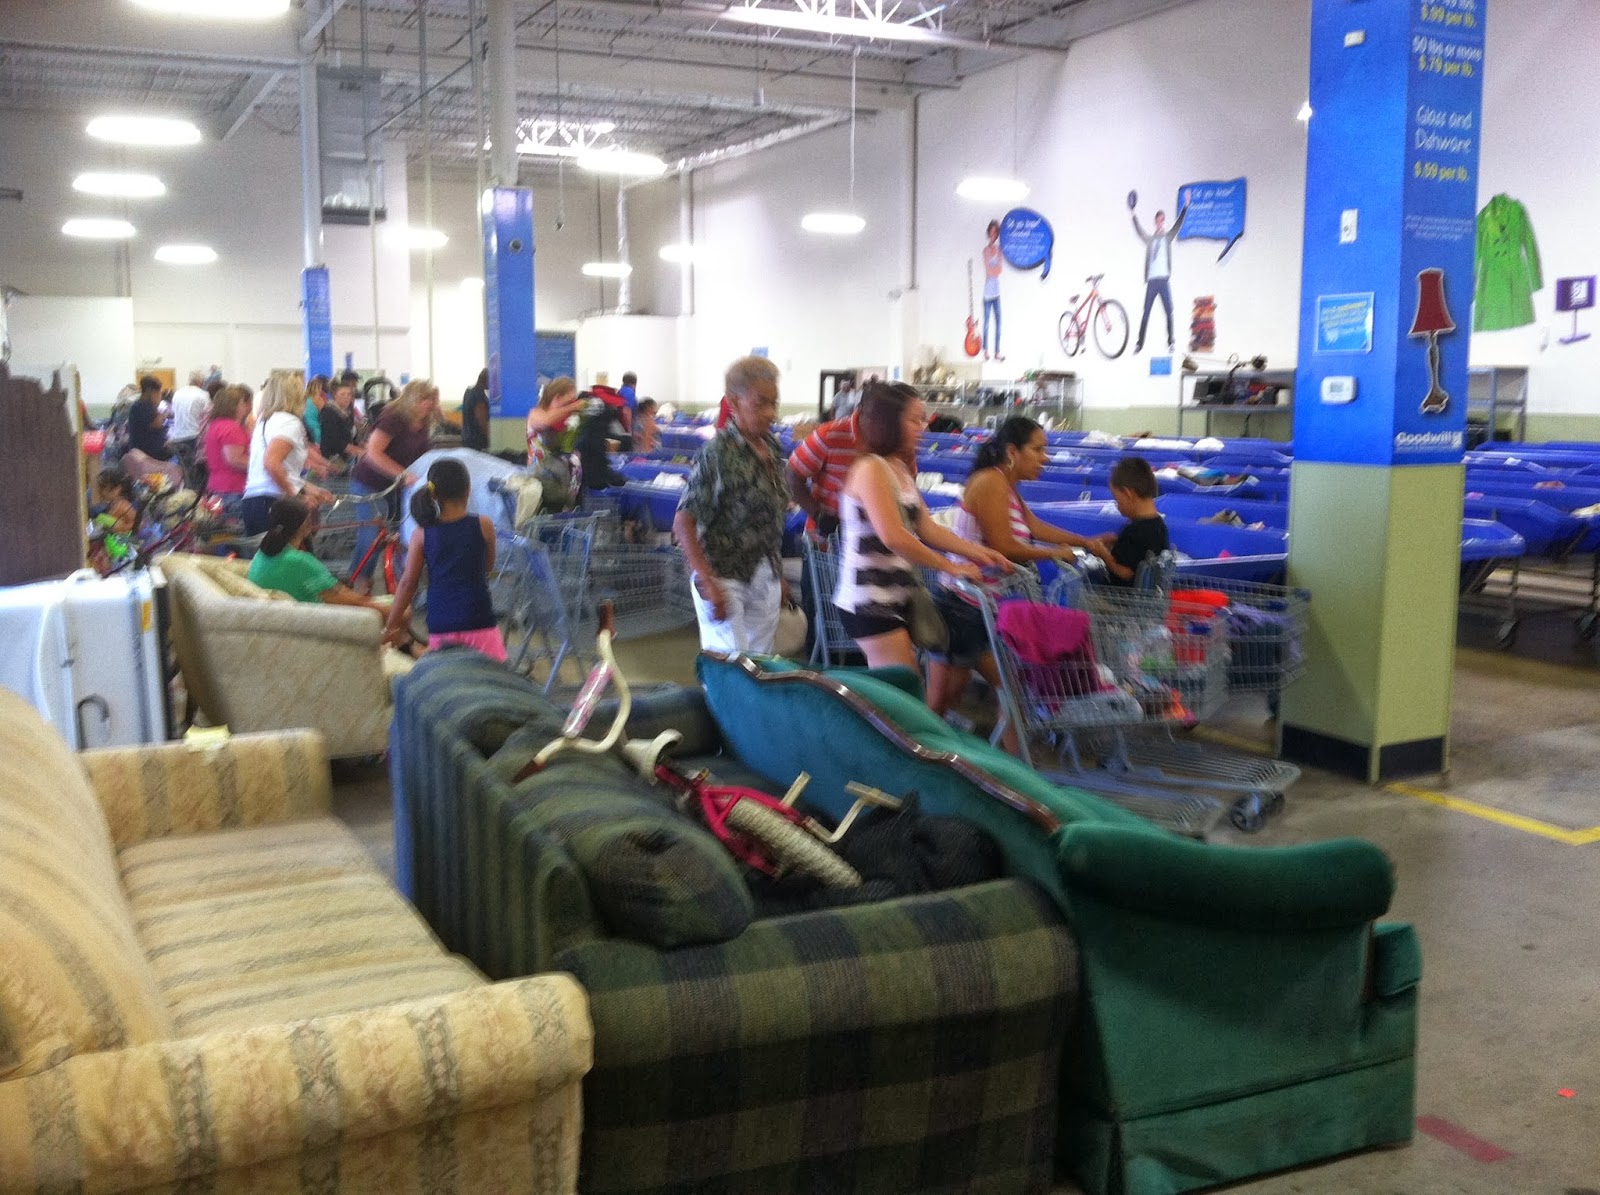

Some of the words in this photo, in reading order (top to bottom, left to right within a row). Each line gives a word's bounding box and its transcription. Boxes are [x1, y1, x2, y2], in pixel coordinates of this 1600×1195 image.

[1457, 46, 1482, 62] more
[1416, 105, 1446, 128] Glass
[1449, 111, 1472, 130] and
[1396, 431, 1452, 445] Goodwill
